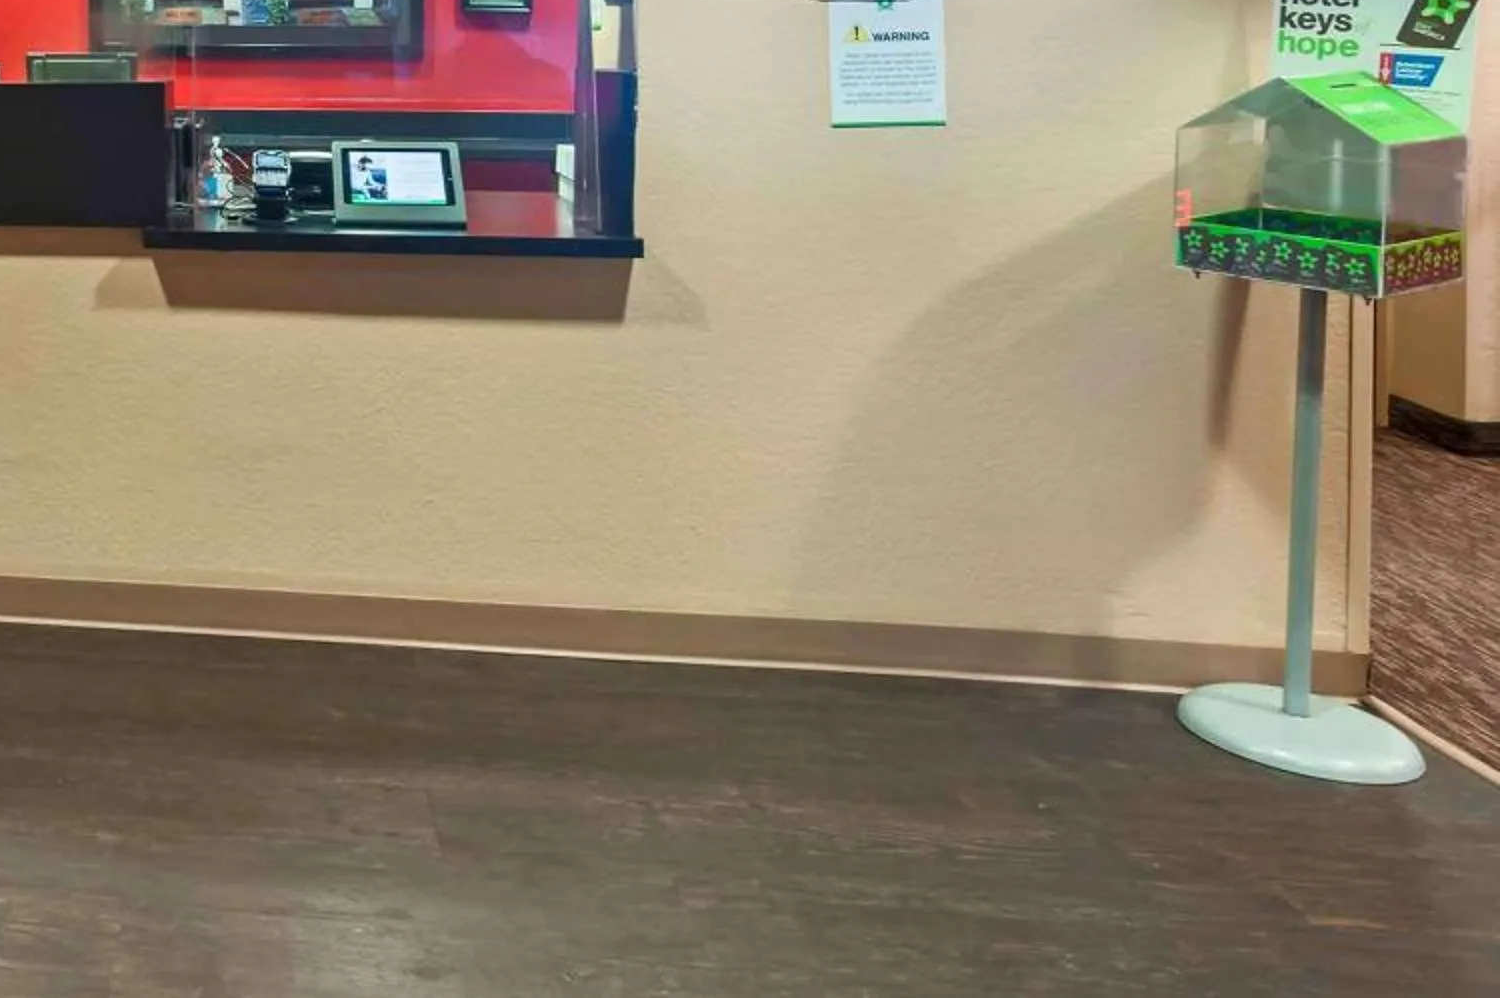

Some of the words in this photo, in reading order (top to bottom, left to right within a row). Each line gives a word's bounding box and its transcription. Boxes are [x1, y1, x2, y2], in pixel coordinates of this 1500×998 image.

[1280, 5, 1353, 35] keys
[872, 31, 930, 42] WARNING
[1278, 30, 1360, 60] hope
